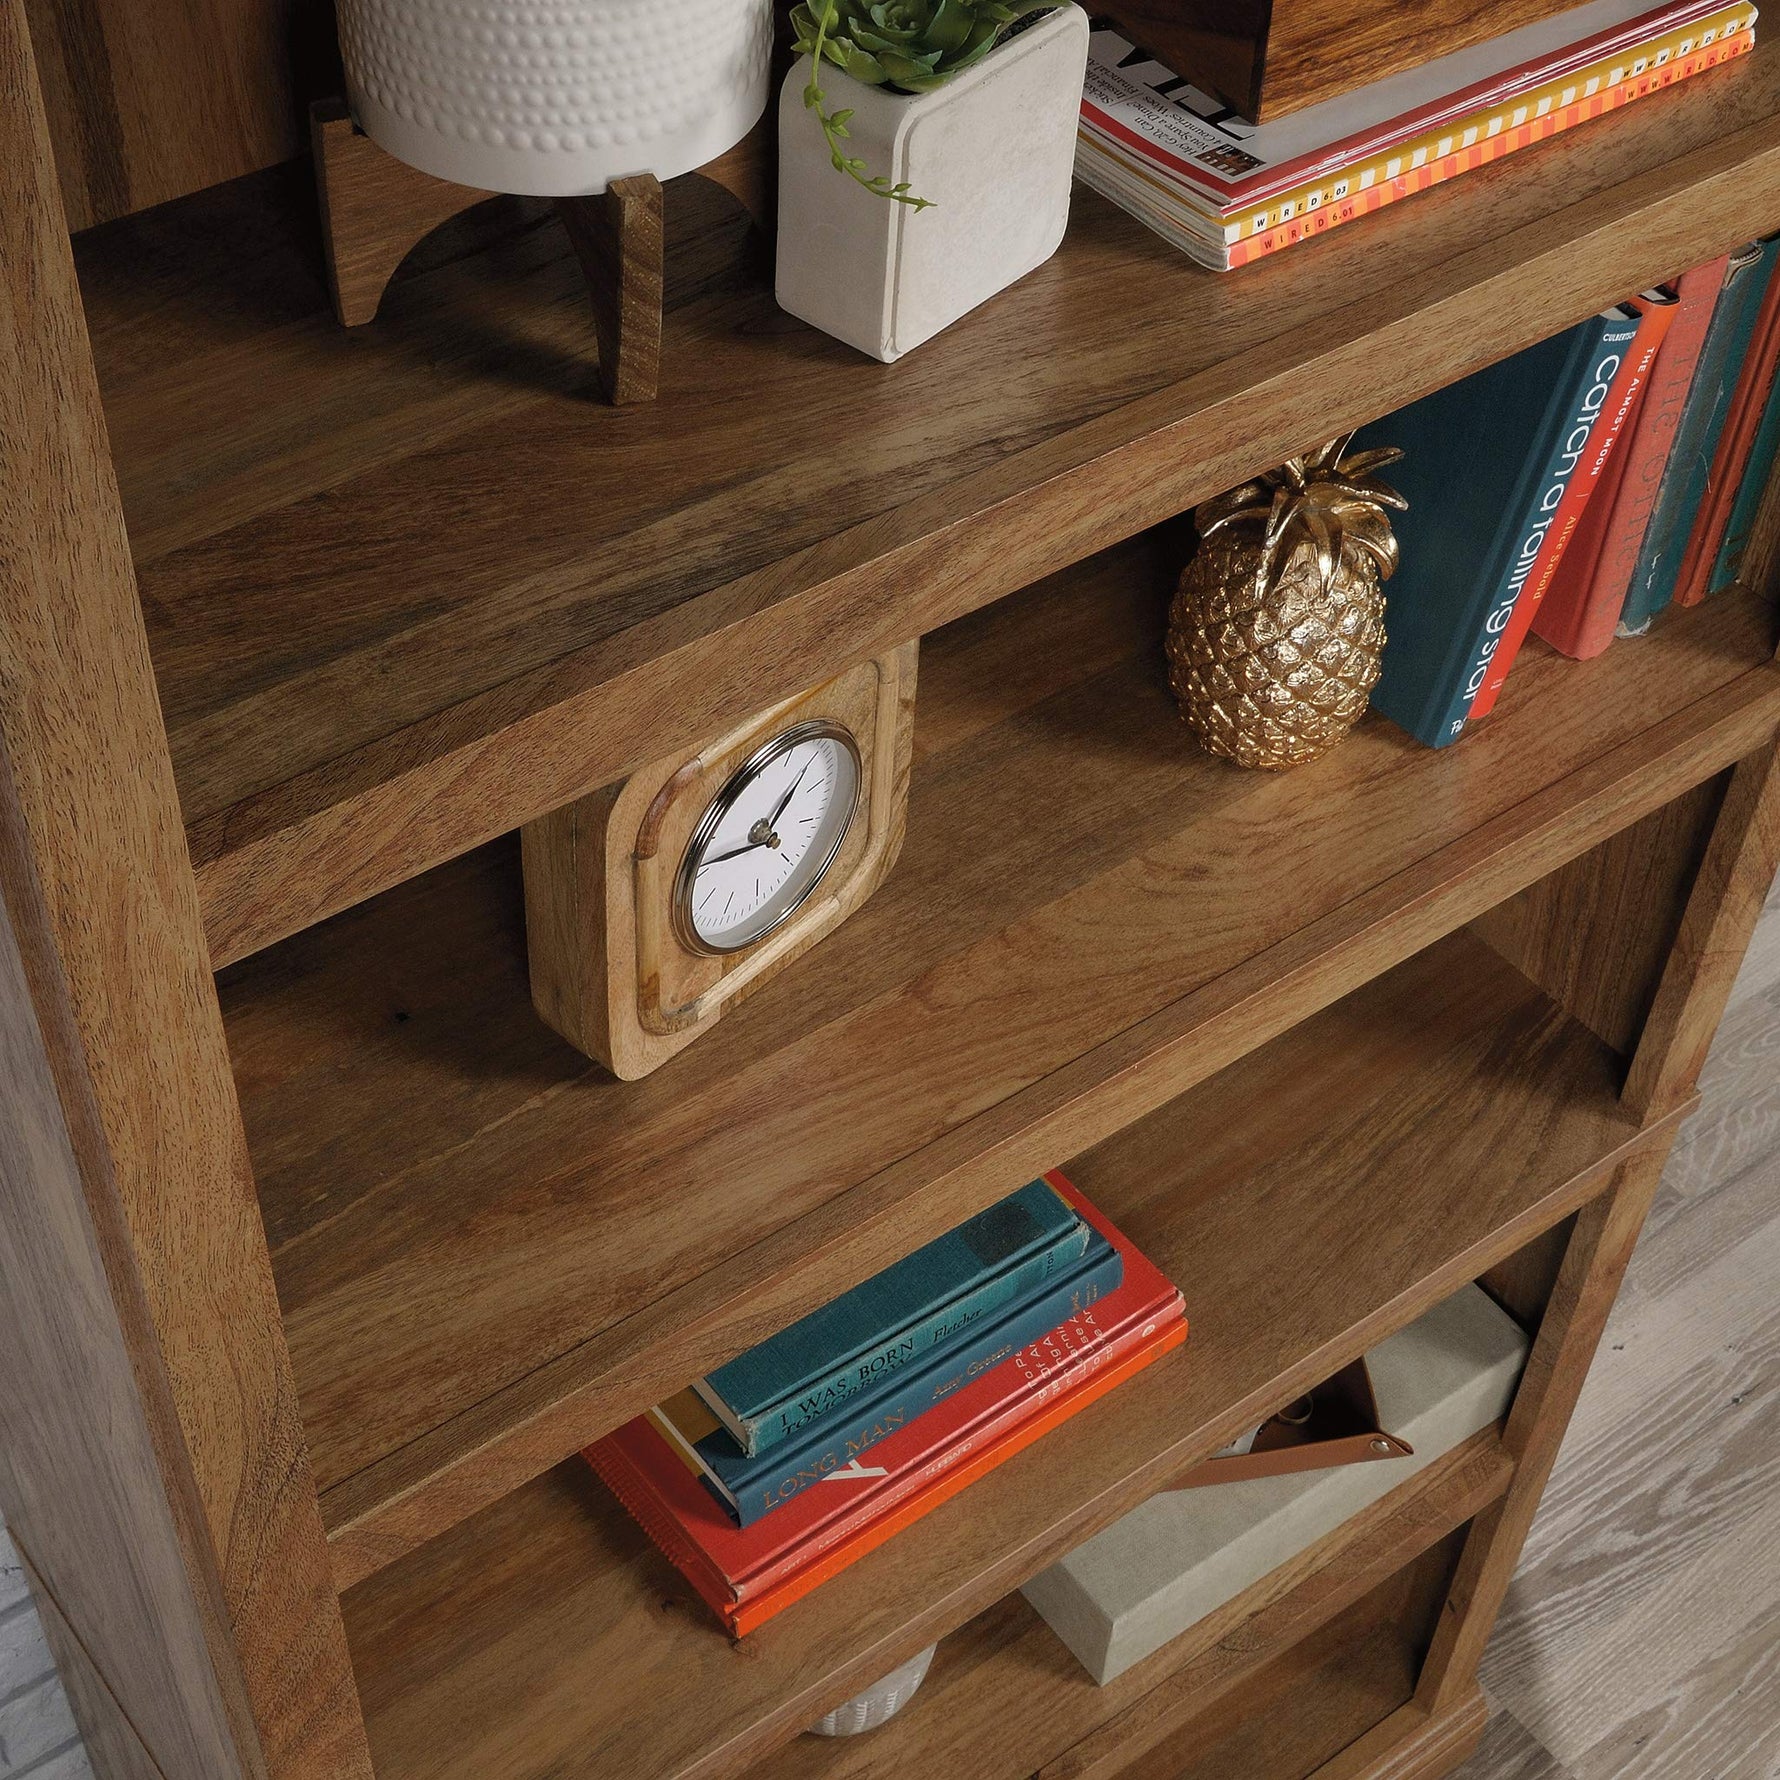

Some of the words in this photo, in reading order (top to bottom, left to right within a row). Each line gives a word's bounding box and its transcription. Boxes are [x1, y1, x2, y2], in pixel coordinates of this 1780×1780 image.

[1134, 116, 1155, 131] Can
[1165, 123, 1191, 141] Spare
[1179, 143, 1198, 157] Hey
[1190, 138, 1209, 151] You
[1256, 197, 1318, 228] WIRED
[1323, 185, 1347, 201] 6.03
[1263, 218, 1325, 250] WIRED
[1332, 206, 1354, 222] 6.01
[1637, 346, 1656, 373] THE
[1554, 354, 1620, 478] catch
[1611, 377, 1640, 432] ALMOST
[1590, 437, 1614, 477] MOON
[1539, 483, 1565, 512] a
[1555, 515, 1577, 550] Alice
[1532, 554, 1560, 600] Sebold
[1462, 637, 1500, 701] star
[779, 1412, 788, 1428] I
[797, 1377, 848, 1413] WAS
[858, 1337, 914, 1381] BORN
[932, 1308, 983, 1344] Fletcher
[763, 1451, 838, 1510] LONG
[846, 1406, 905, 1458] MAN
